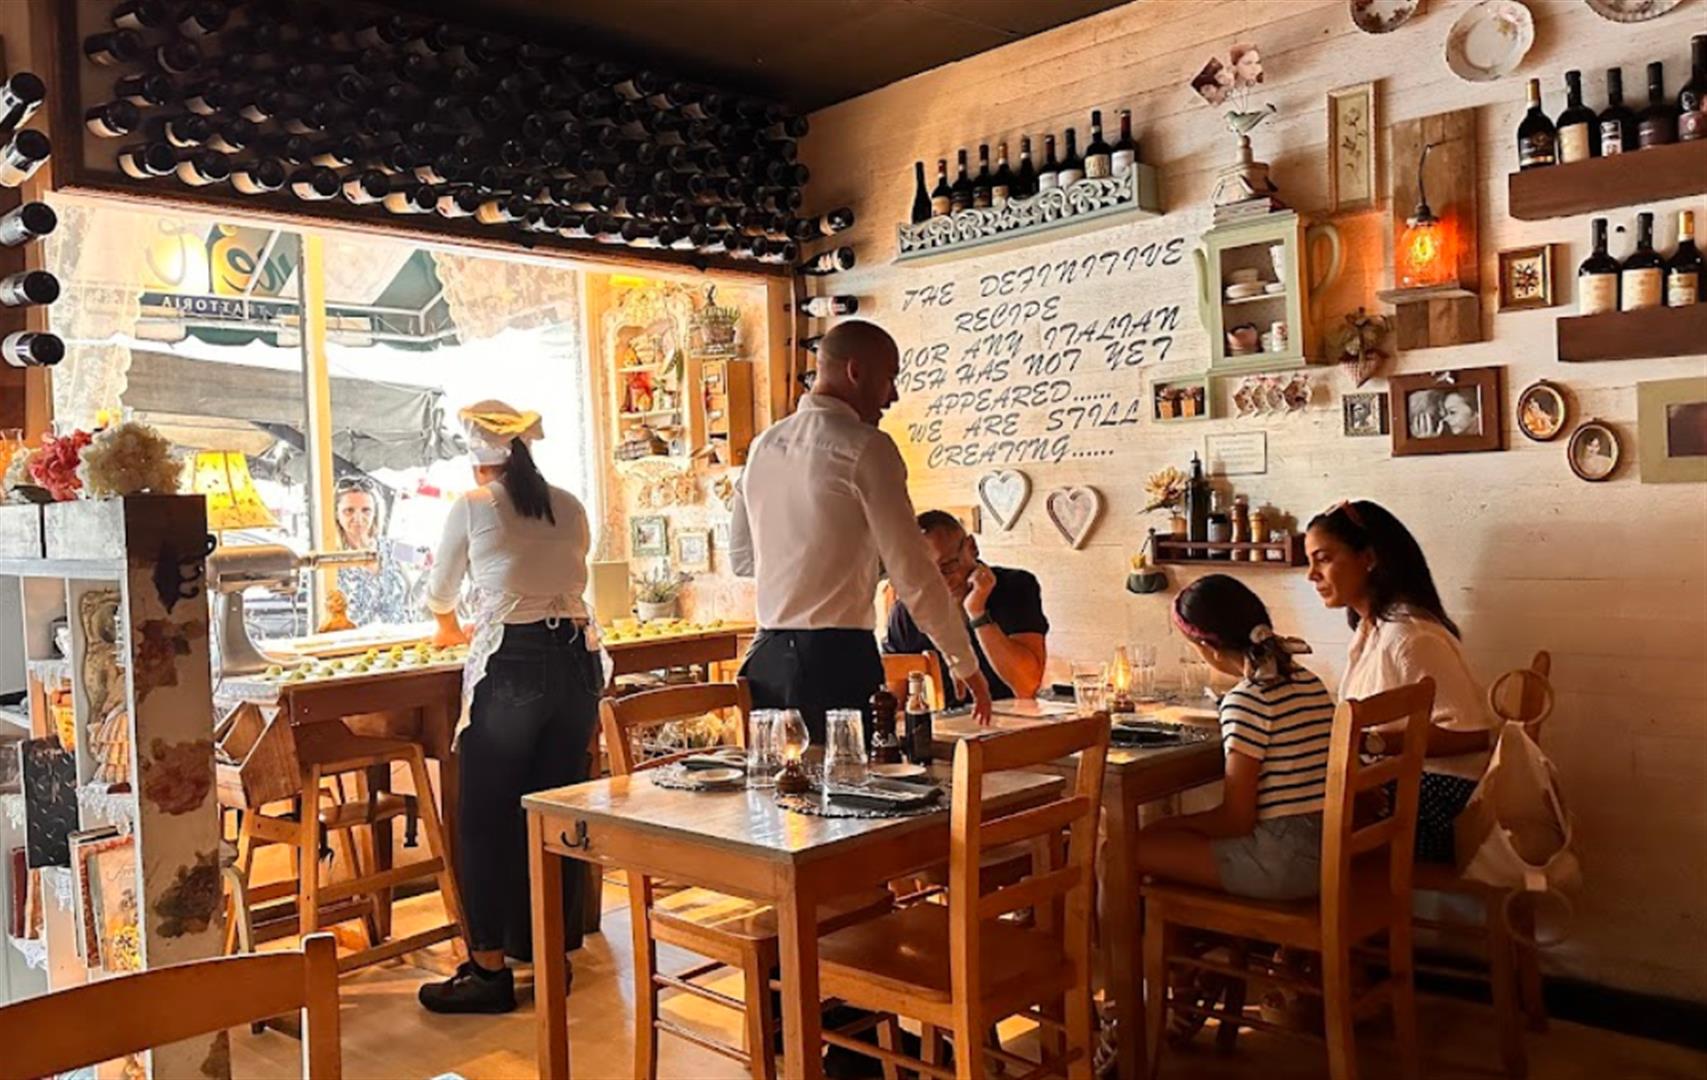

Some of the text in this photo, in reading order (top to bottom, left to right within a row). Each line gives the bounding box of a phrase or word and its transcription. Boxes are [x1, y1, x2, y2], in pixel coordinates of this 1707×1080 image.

[902, 238, 1184, 311] THE DEFINITIVE
[955, 296, 1060, 334] RECIPE
[961, 330, 1024, 362] ANY
[1044, 305, 1180, 350] ITALIAN
[895, 336, 1172, 393] ISH HAS NOT YET
[908, 399, 1140, 442] WE ARE STILL
